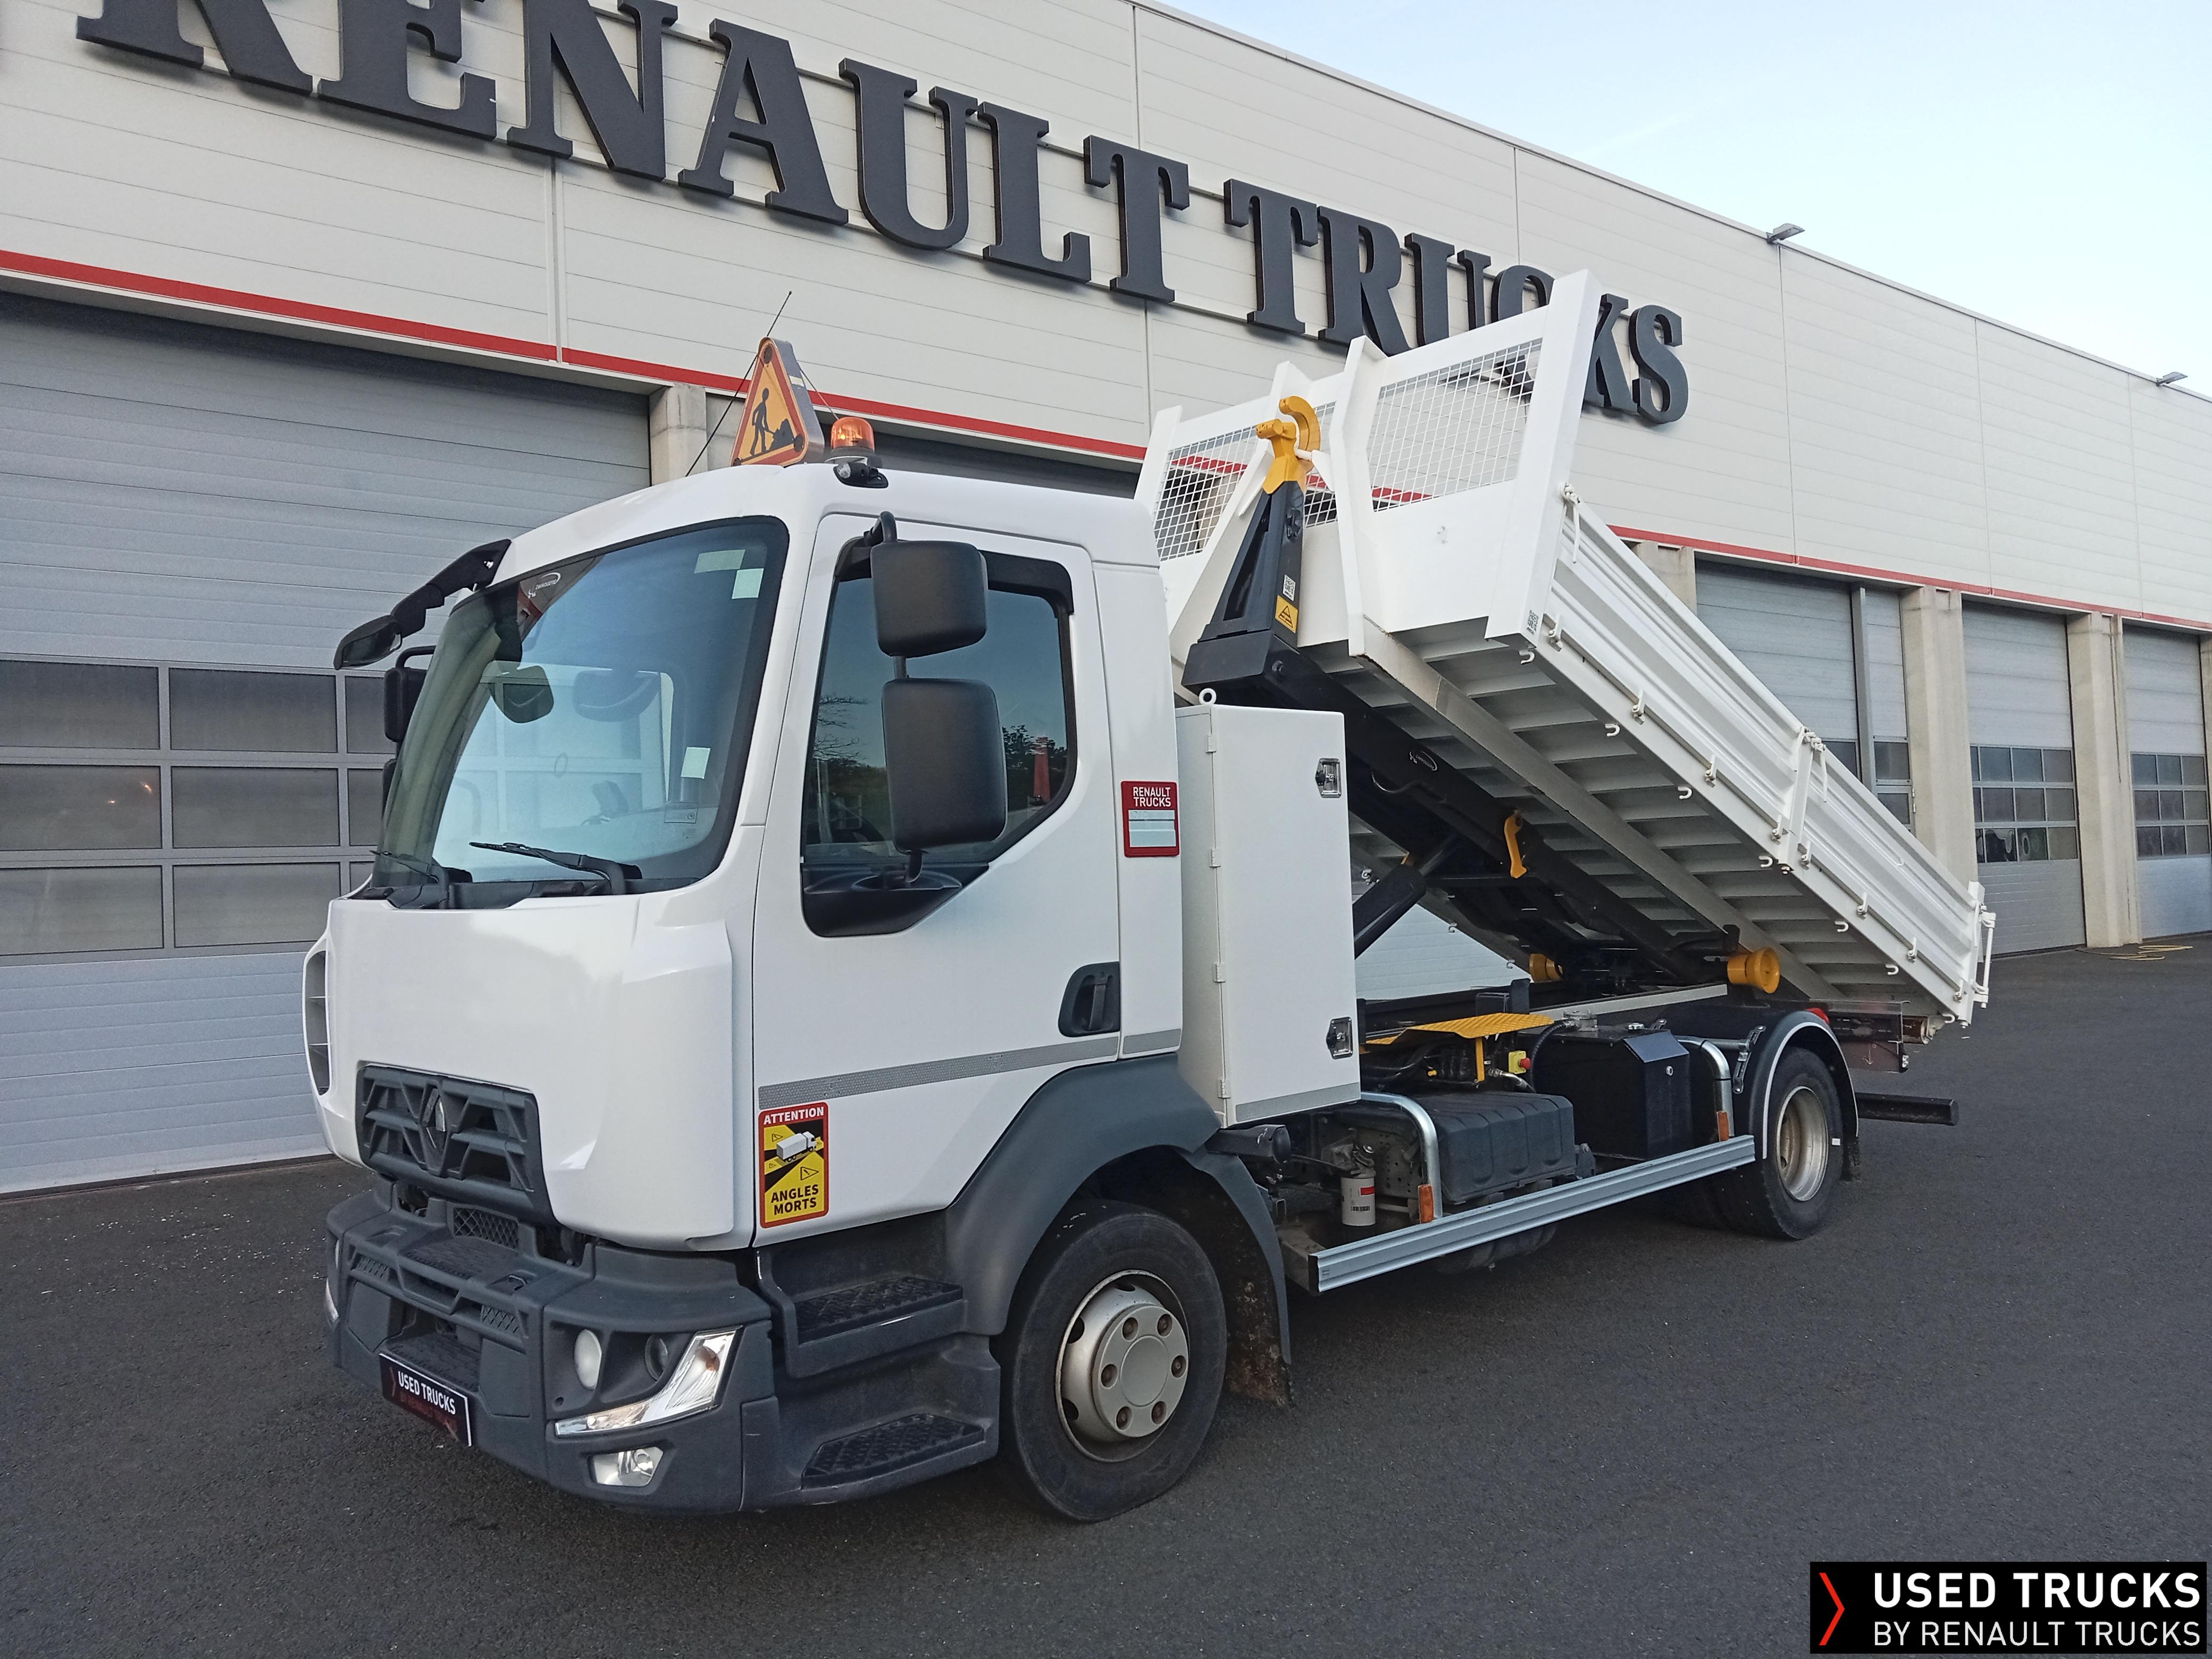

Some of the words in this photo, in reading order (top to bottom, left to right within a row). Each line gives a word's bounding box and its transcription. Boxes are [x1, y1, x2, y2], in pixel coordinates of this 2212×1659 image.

[1133, 787, 1171, 797] RENAULT
[1133, 797, 1171, 807] TRUCKS
[764, 1107, 824, 1125] ATTENTION
[771, 1184, 819, 1203] ANGLES
[774, 1197, 817, 1216] MORTS
[398, 1371, 420, 1396] USED
[421, 1382, 456, 1415] TRUCKS
